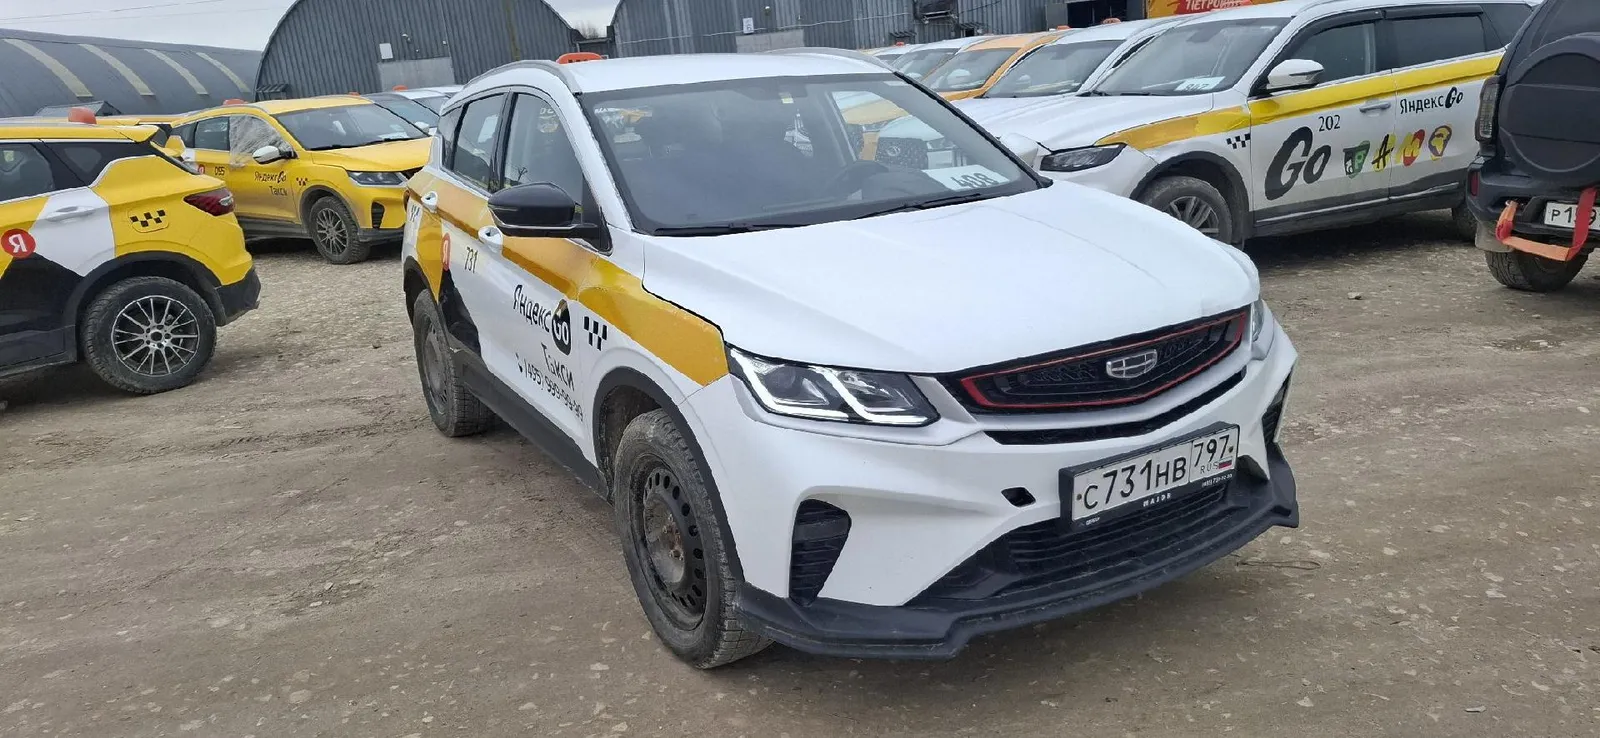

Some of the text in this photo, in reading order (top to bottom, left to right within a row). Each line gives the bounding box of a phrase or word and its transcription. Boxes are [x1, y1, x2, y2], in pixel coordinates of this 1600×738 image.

[1400, 87, 1464, 114] Яндекс Go
[1319, 115, 1341, 132] 202
[1265, 127, 1331, 200] Go
[8, 233, 28, 253] Я
[464, 246, 479, 274] 731
[513, 284, 552, 333] Яндекс
[524, 358, 544, 389] (495)
[541, 342, 575, 392] Такси
[1194, 434, 1231, 468] 797
[1200, 462, 1220, 475] RUS
